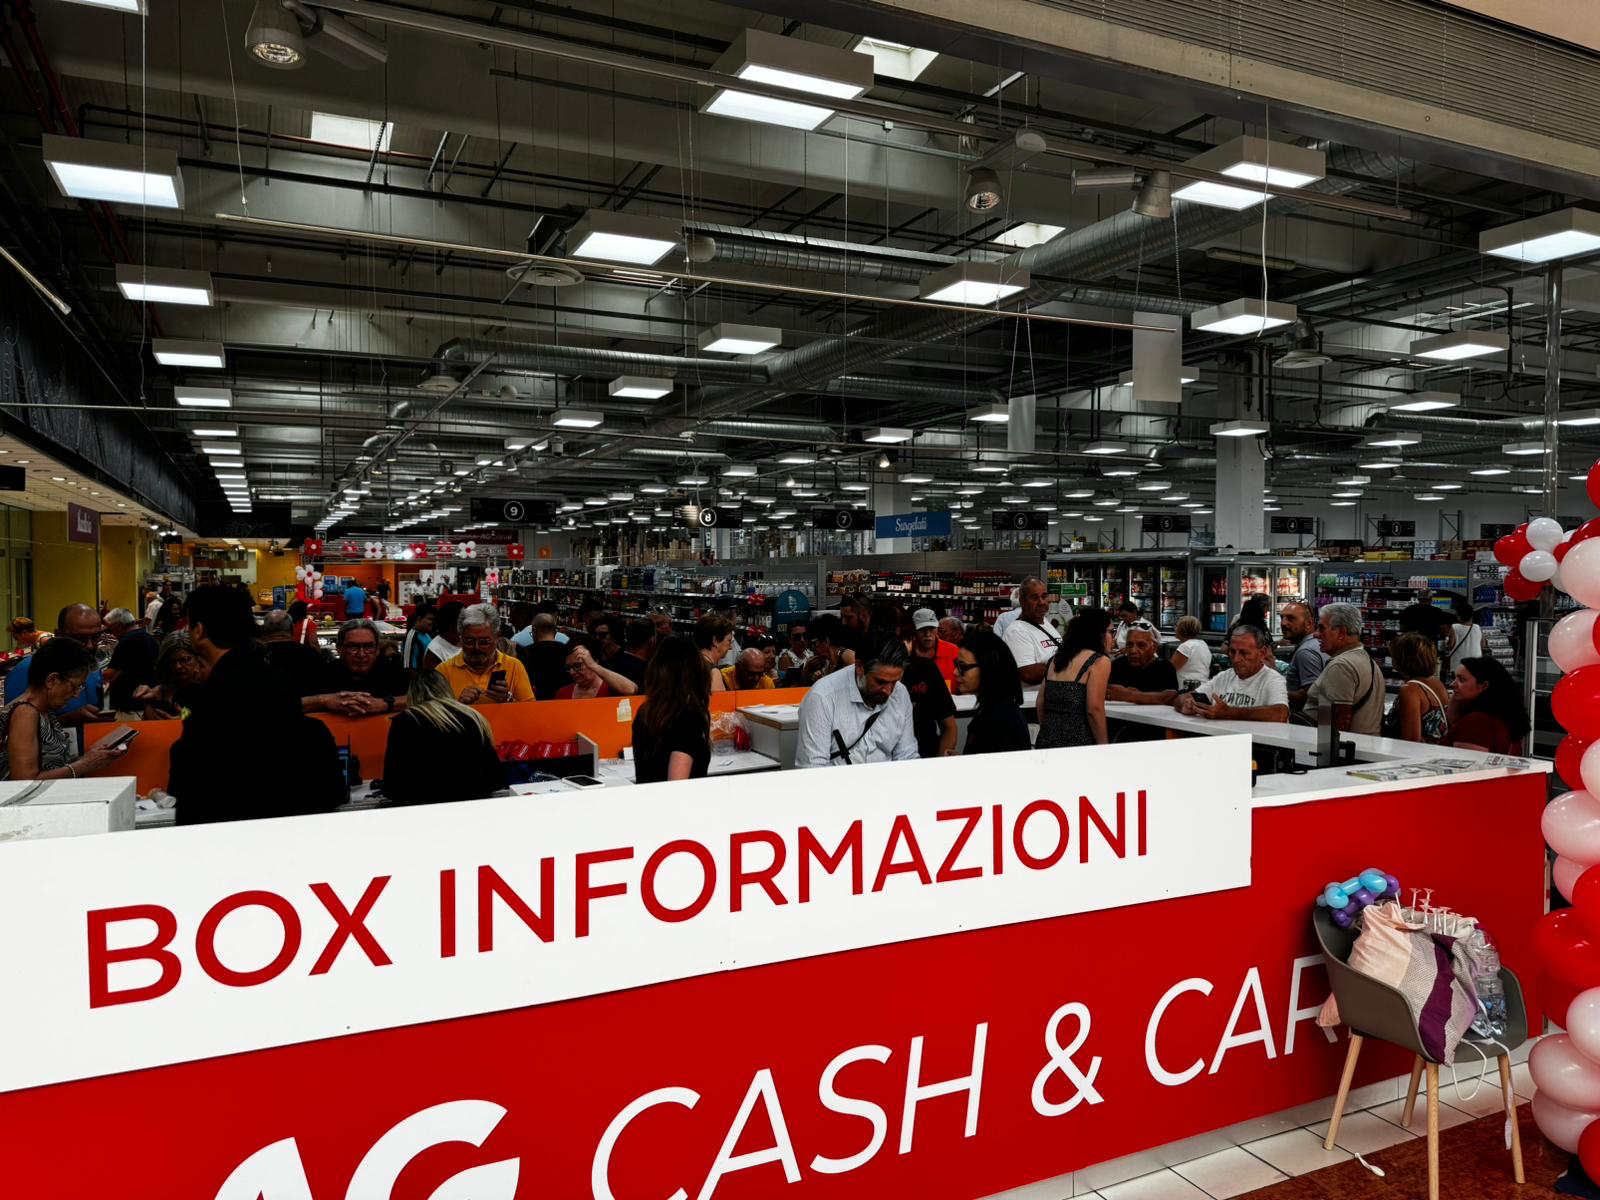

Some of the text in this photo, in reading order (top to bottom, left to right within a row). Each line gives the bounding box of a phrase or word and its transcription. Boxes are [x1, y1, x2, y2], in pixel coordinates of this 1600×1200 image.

[509, 506, 519, 516] 9
[841, 515, 848, 525] 7
[88, 791, 1146, 1008] BOX INFORMAZIONI
[592, 1022, 988, 1200] CASH
[1031, 1002, 1104, 1116] &
[1145, 954, 1351, 1086] CAR
